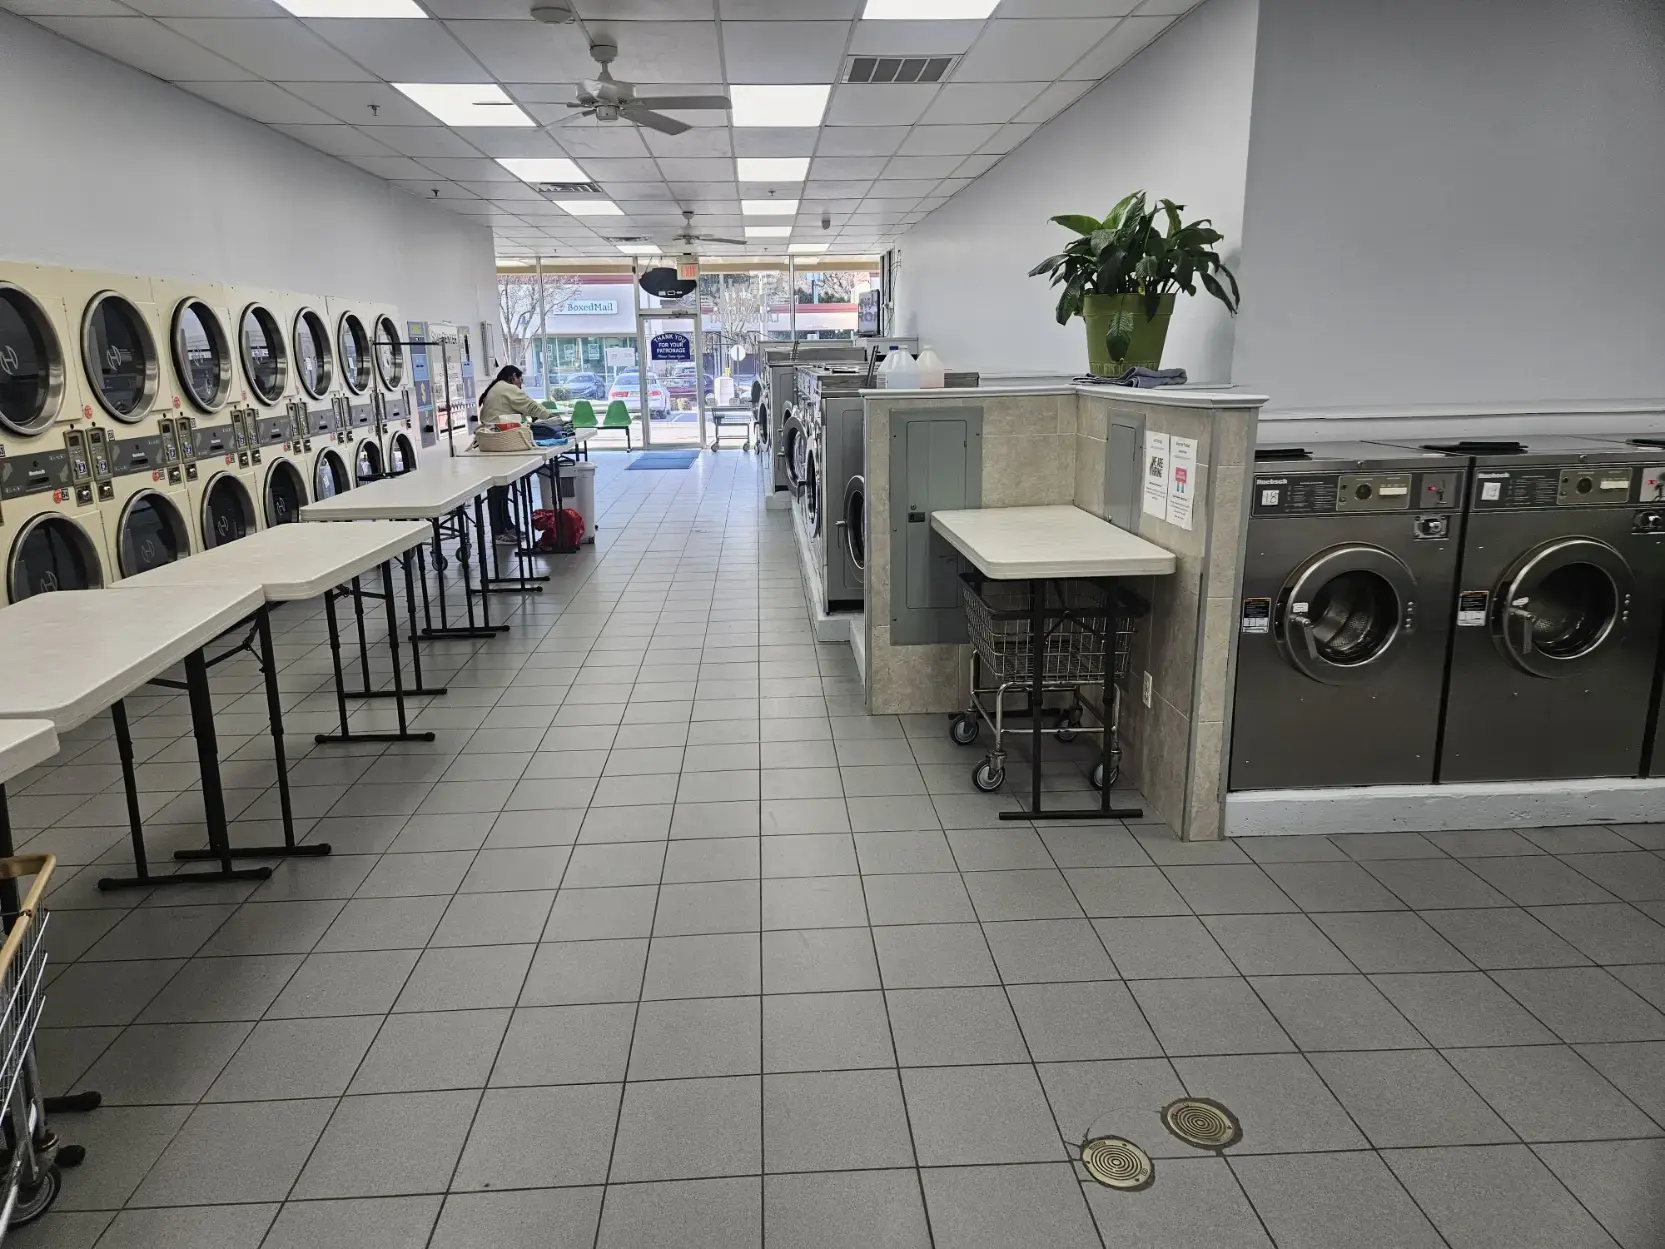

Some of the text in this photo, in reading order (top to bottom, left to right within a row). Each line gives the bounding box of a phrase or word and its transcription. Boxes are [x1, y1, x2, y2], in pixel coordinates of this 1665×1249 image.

[681, 264, 696, 278] EXIT
[567, 302, 614, 312] BoxedMail
[654, 333, 687, 343] THANK YOU
